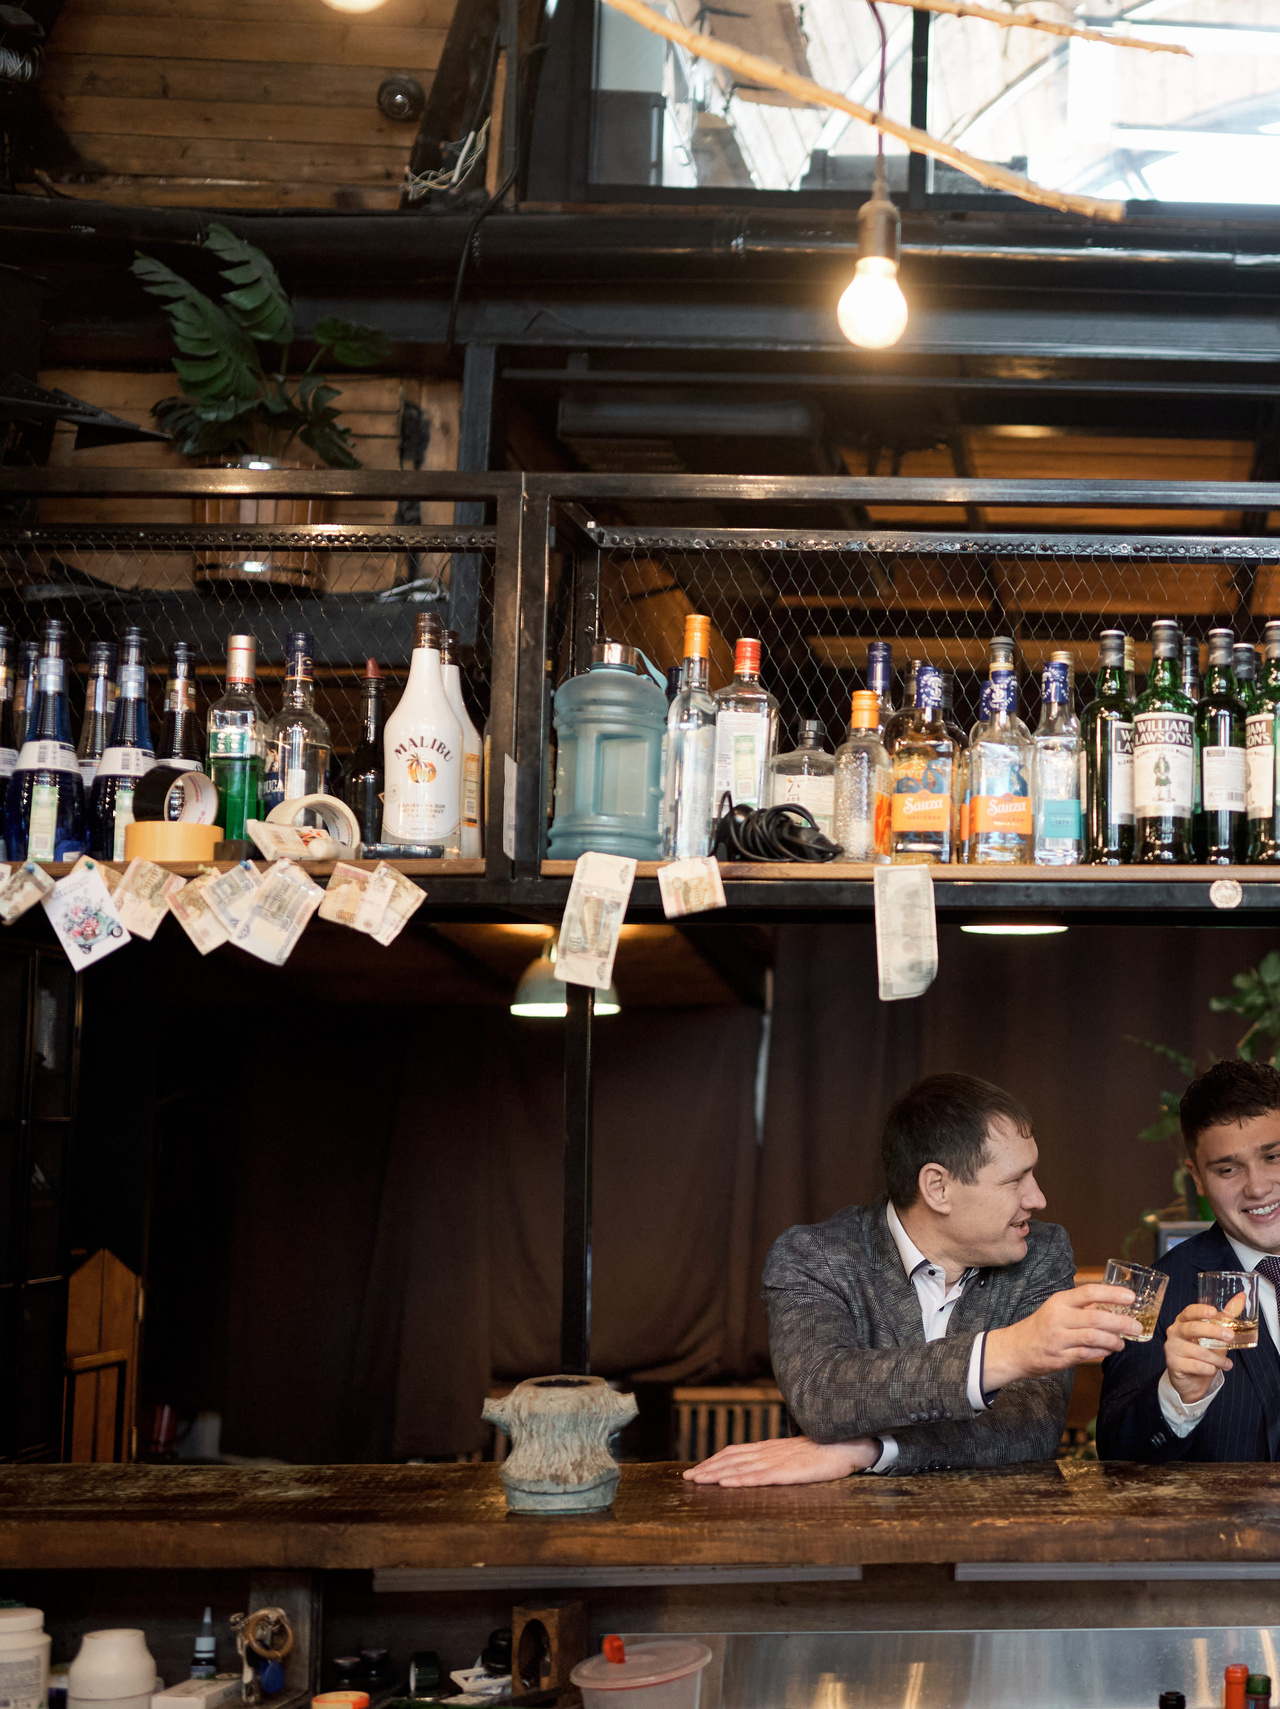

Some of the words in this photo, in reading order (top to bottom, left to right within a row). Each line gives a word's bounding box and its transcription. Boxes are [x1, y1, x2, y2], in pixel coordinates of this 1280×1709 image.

[1136, 720, 1190, 733] WILLIAM
[1135, 731, 1192, 745] LAWSON'S
[394, 736, 454, 762] MALIBU
[903, 797, 943, 815] Sauza
[987, 799, 1027, 816] Sauza
